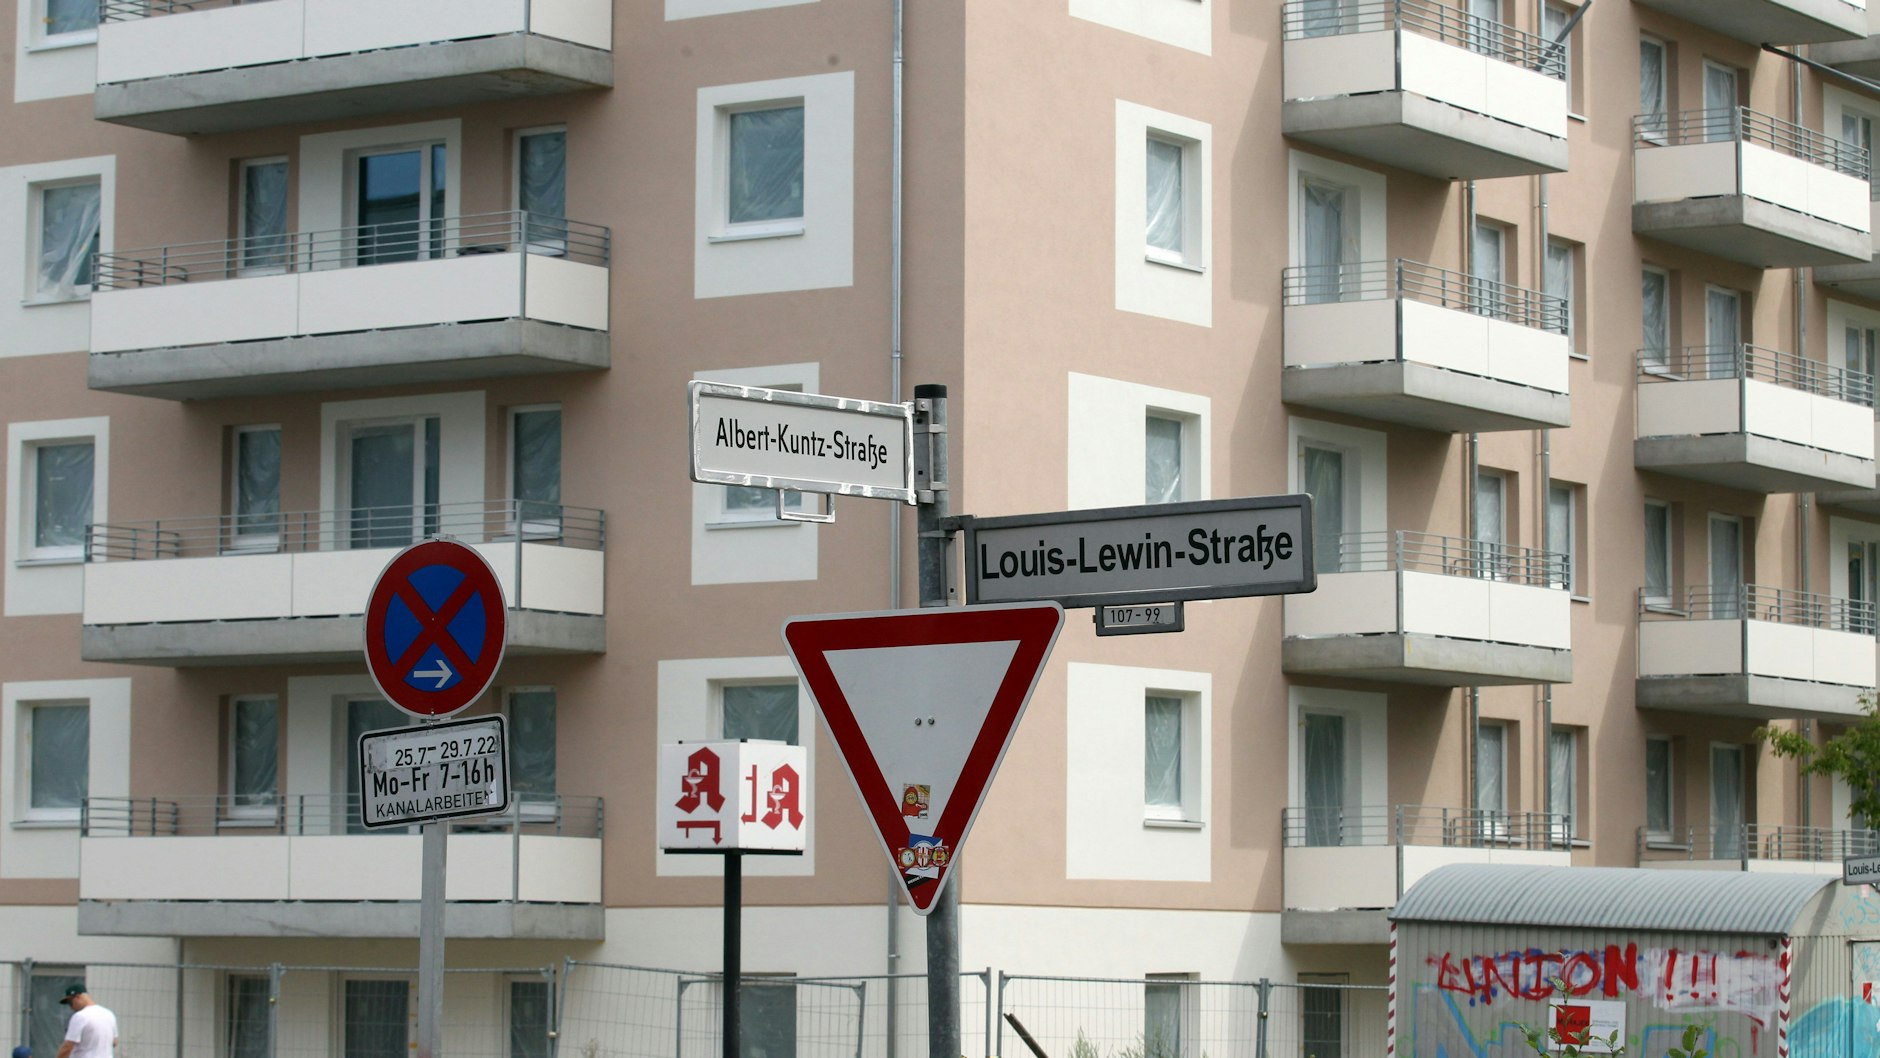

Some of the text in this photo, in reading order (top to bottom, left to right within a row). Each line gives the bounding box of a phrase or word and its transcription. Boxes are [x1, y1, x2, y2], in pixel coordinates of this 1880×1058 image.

[716, 417, 887, 469] Albert-Kuntz-Straße
[981, 524, 1294, 580] Louis-Lewin-Straße
[373, 758, 494, 798] Mo-Fr 7-16h
